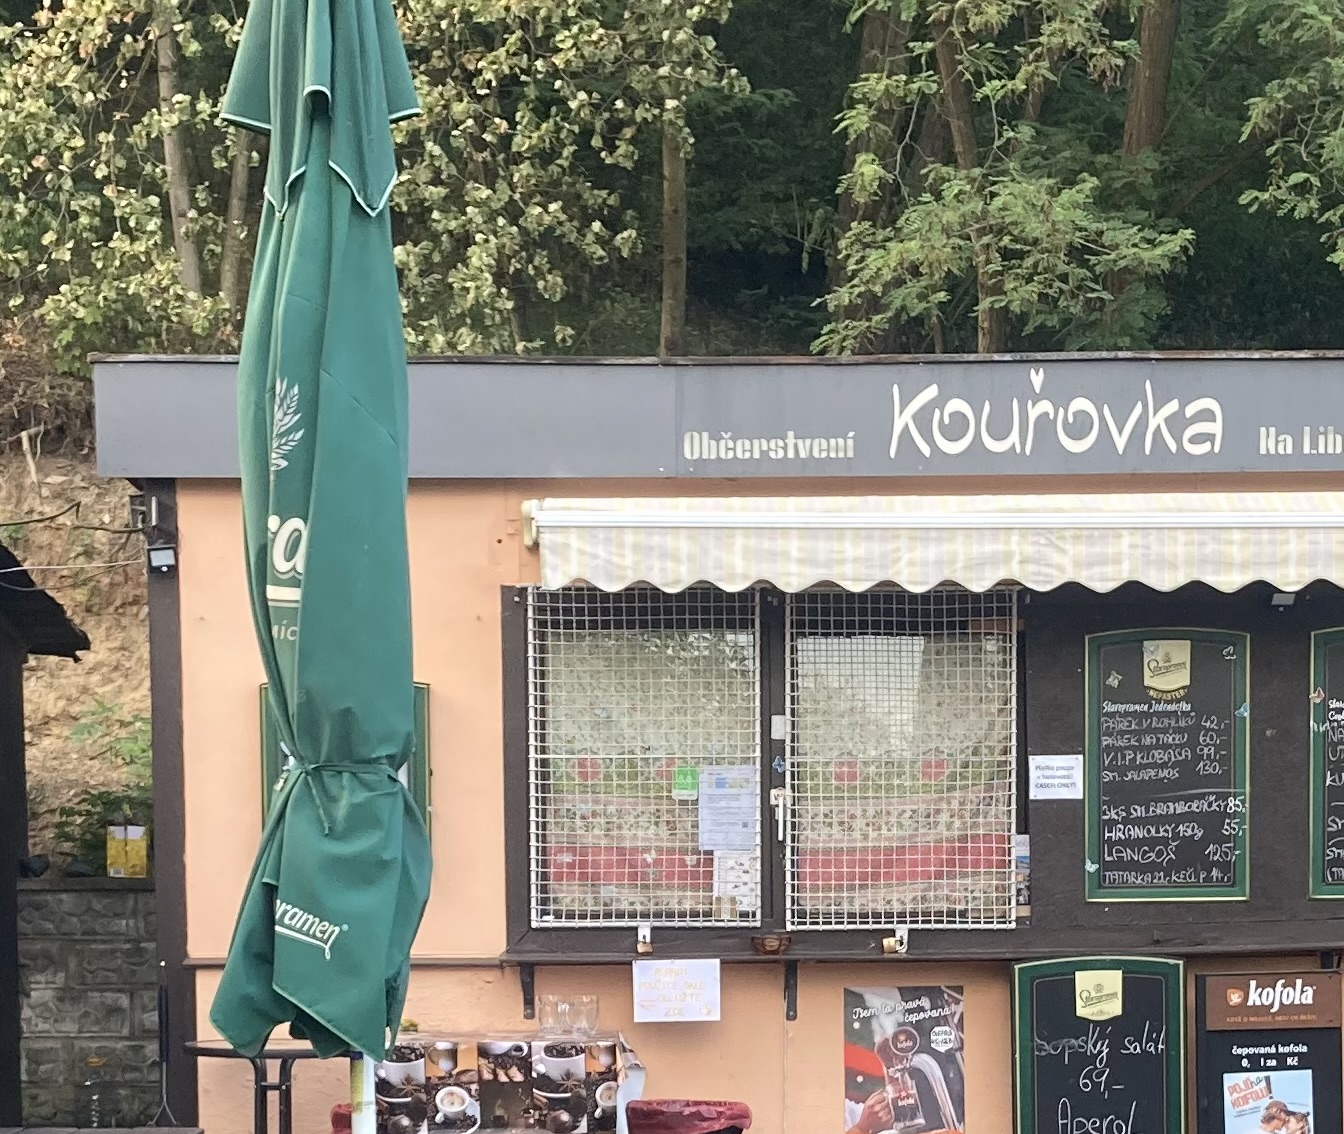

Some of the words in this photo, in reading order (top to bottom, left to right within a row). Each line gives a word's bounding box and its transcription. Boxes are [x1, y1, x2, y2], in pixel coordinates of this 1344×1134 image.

[683, 431, 856, 460] Občerstvení
[887, 367, 1225, 460] Kouřovka
[1259, 426, 1293, 455] Na
[1104, 823, 1176, 841] HRANOLKY
[1247, 978, 1314, 1013] kofola
[1231, 1045, 1276, 1057] čepovaná
[1277, 1044, 1308, 1054] kofola
[1266, 1059, 1277, 1067] za
[1286, 1056, 1299, 1066] Kč
[1079, 1066, 1125, 1099] 69,-
